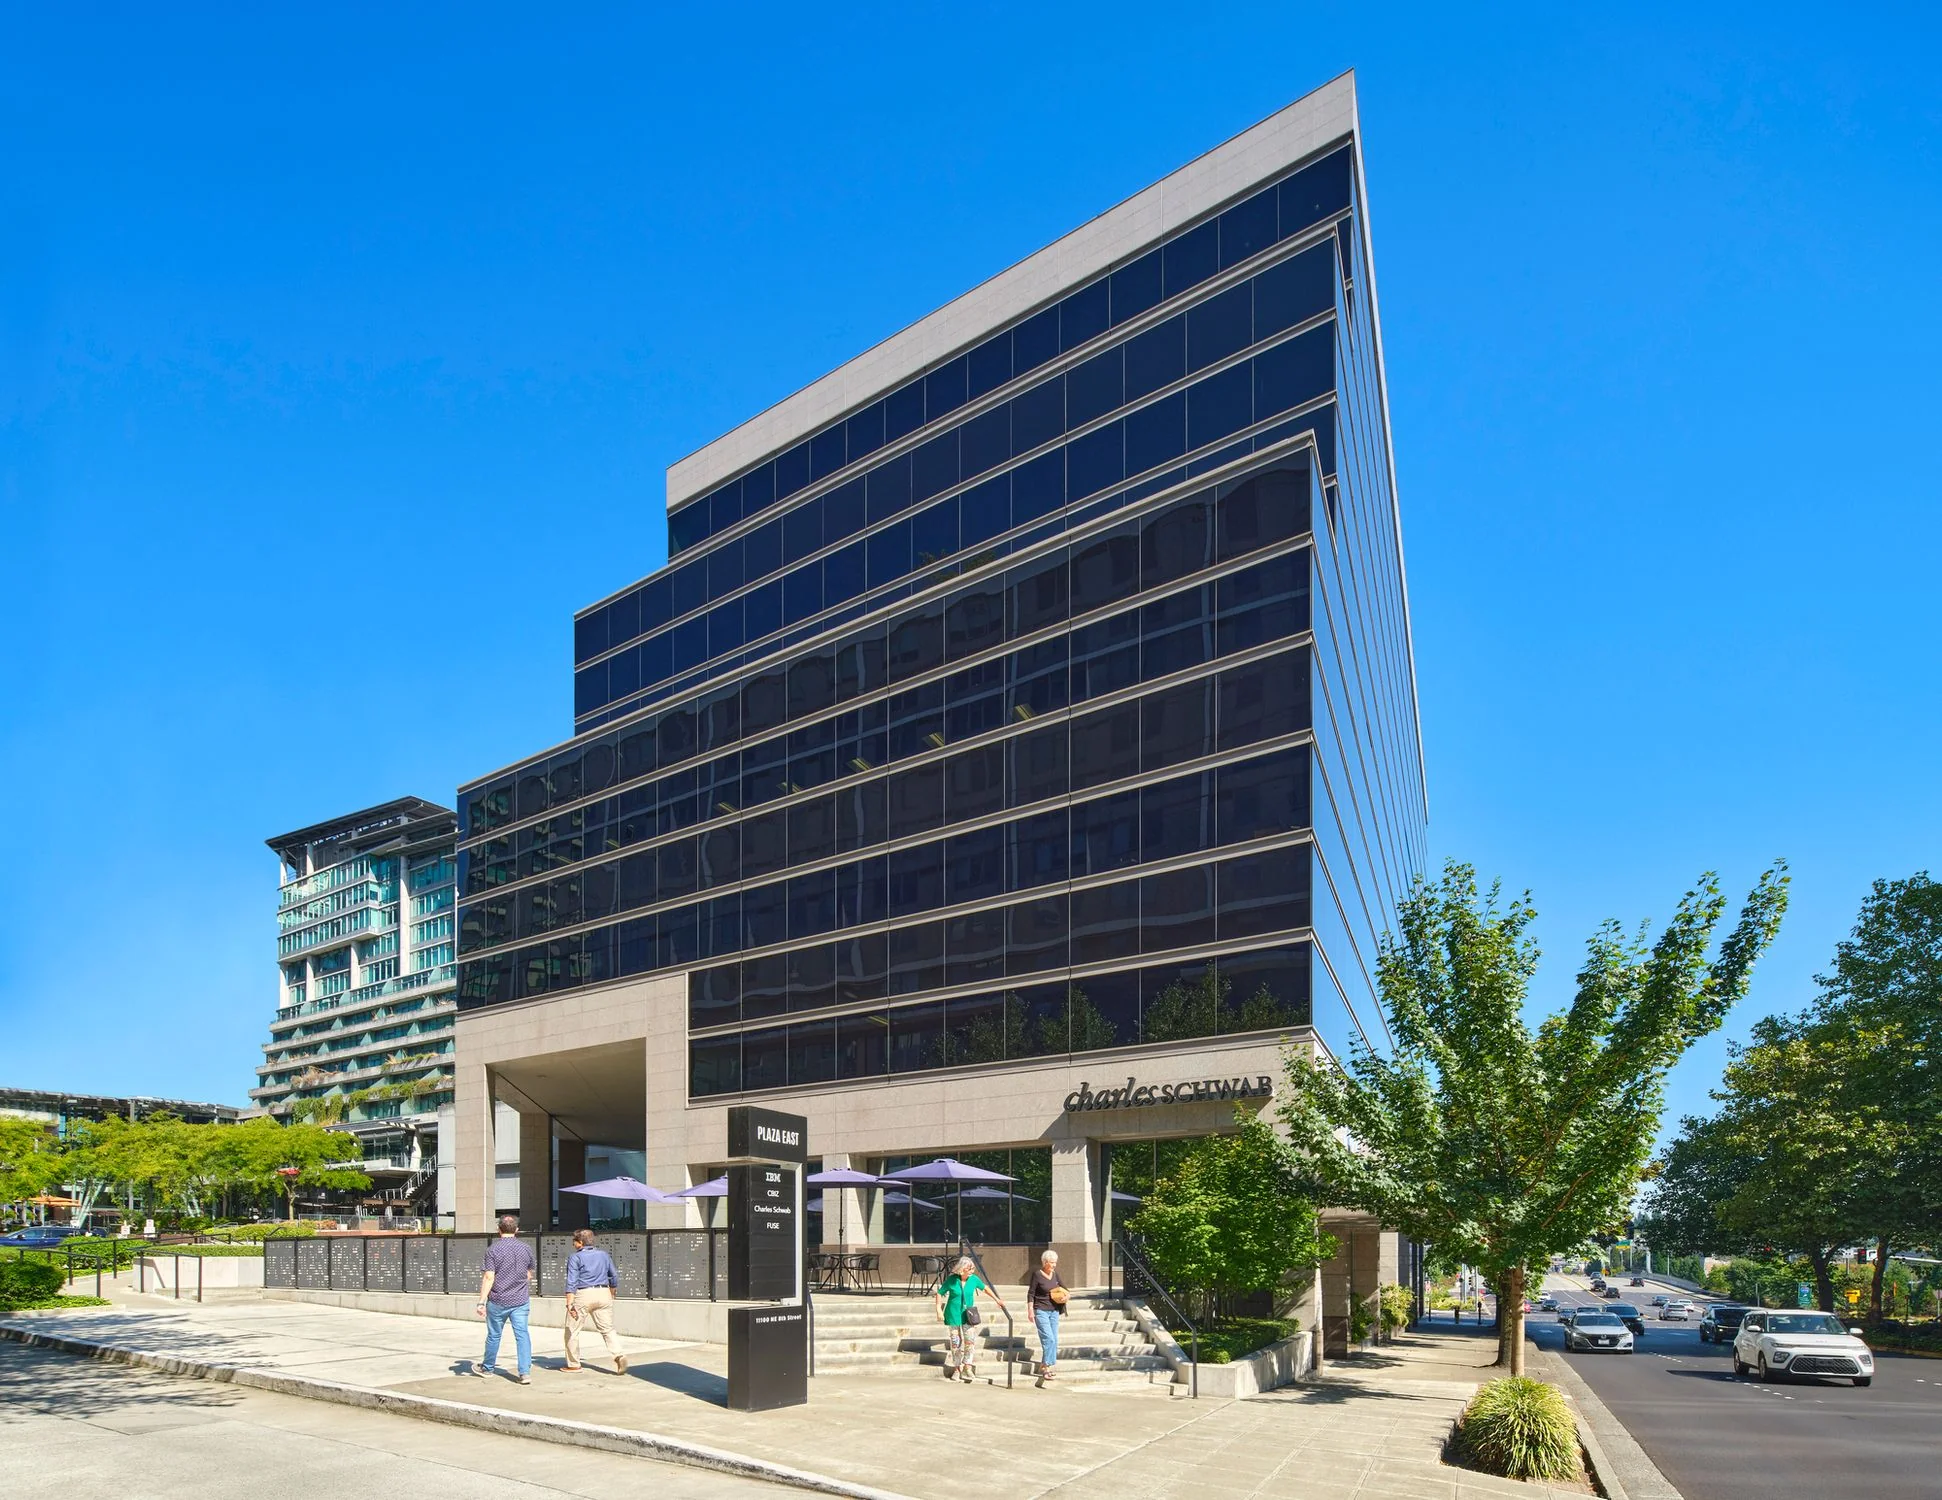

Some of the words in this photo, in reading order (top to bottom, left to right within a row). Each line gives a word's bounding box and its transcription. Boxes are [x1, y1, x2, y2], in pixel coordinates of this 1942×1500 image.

[1063, 1077, 1160, 1112] charles
[1161, 1075, 1274, 1104] SCHWAB
[757, 1126, 781, 1143] PLAZA
[782, 1130, 799, 1146] EAST
[765, 1172, 781, 1183] IBM
[754, 1205, 773, 1213] Charles
[773, 1206, 792, 1214] Schwab
